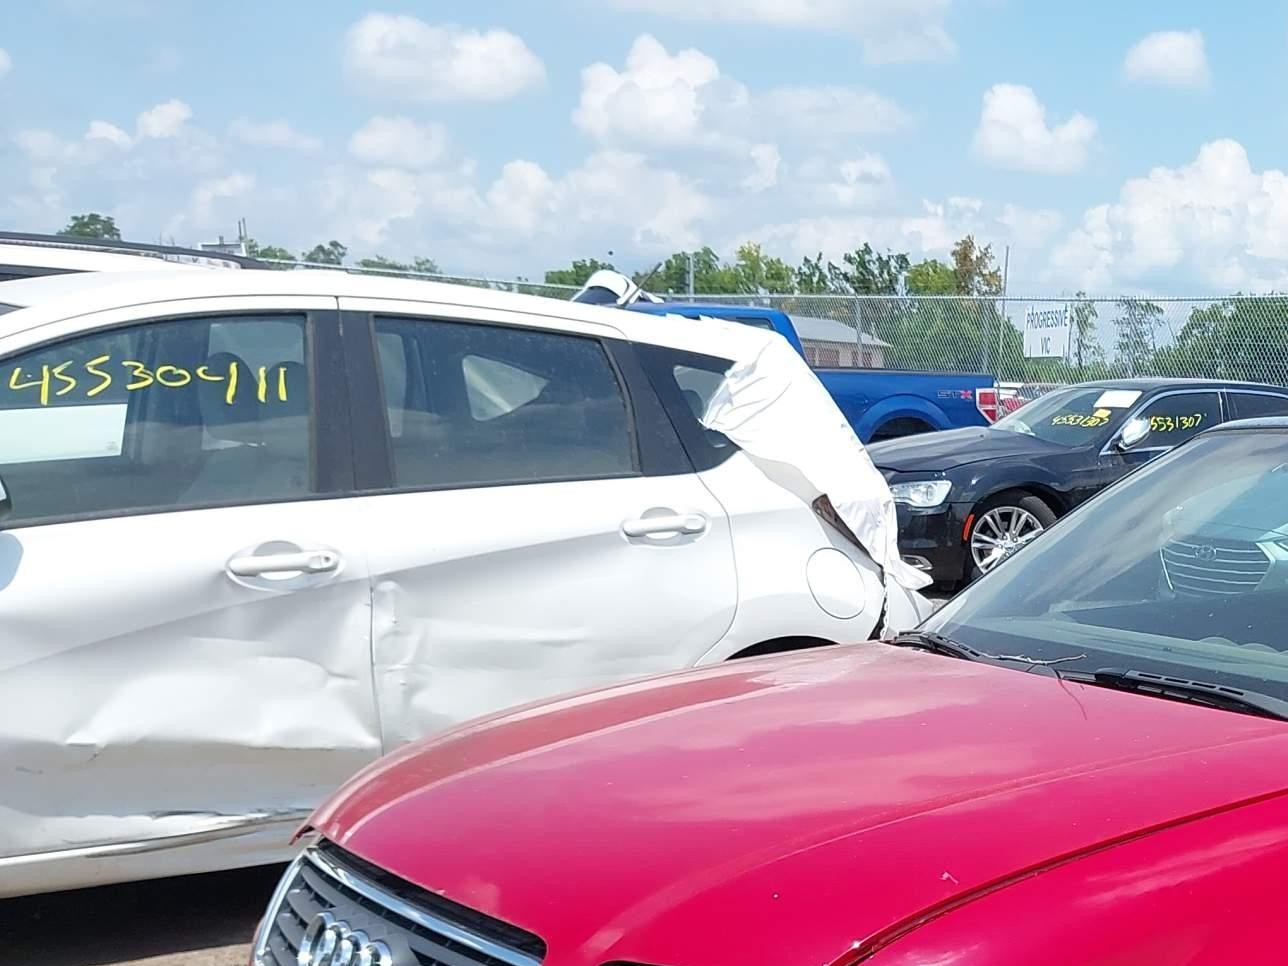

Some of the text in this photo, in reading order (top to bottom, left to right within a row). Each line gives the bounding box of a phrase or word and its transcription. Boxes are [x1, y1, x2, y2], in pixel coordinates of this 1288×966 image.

[1026, 310, 1068, 329] PROGRESSIVE
[9, 355, 288, 406] 45530411
[937, 390, 973, 400] STX
